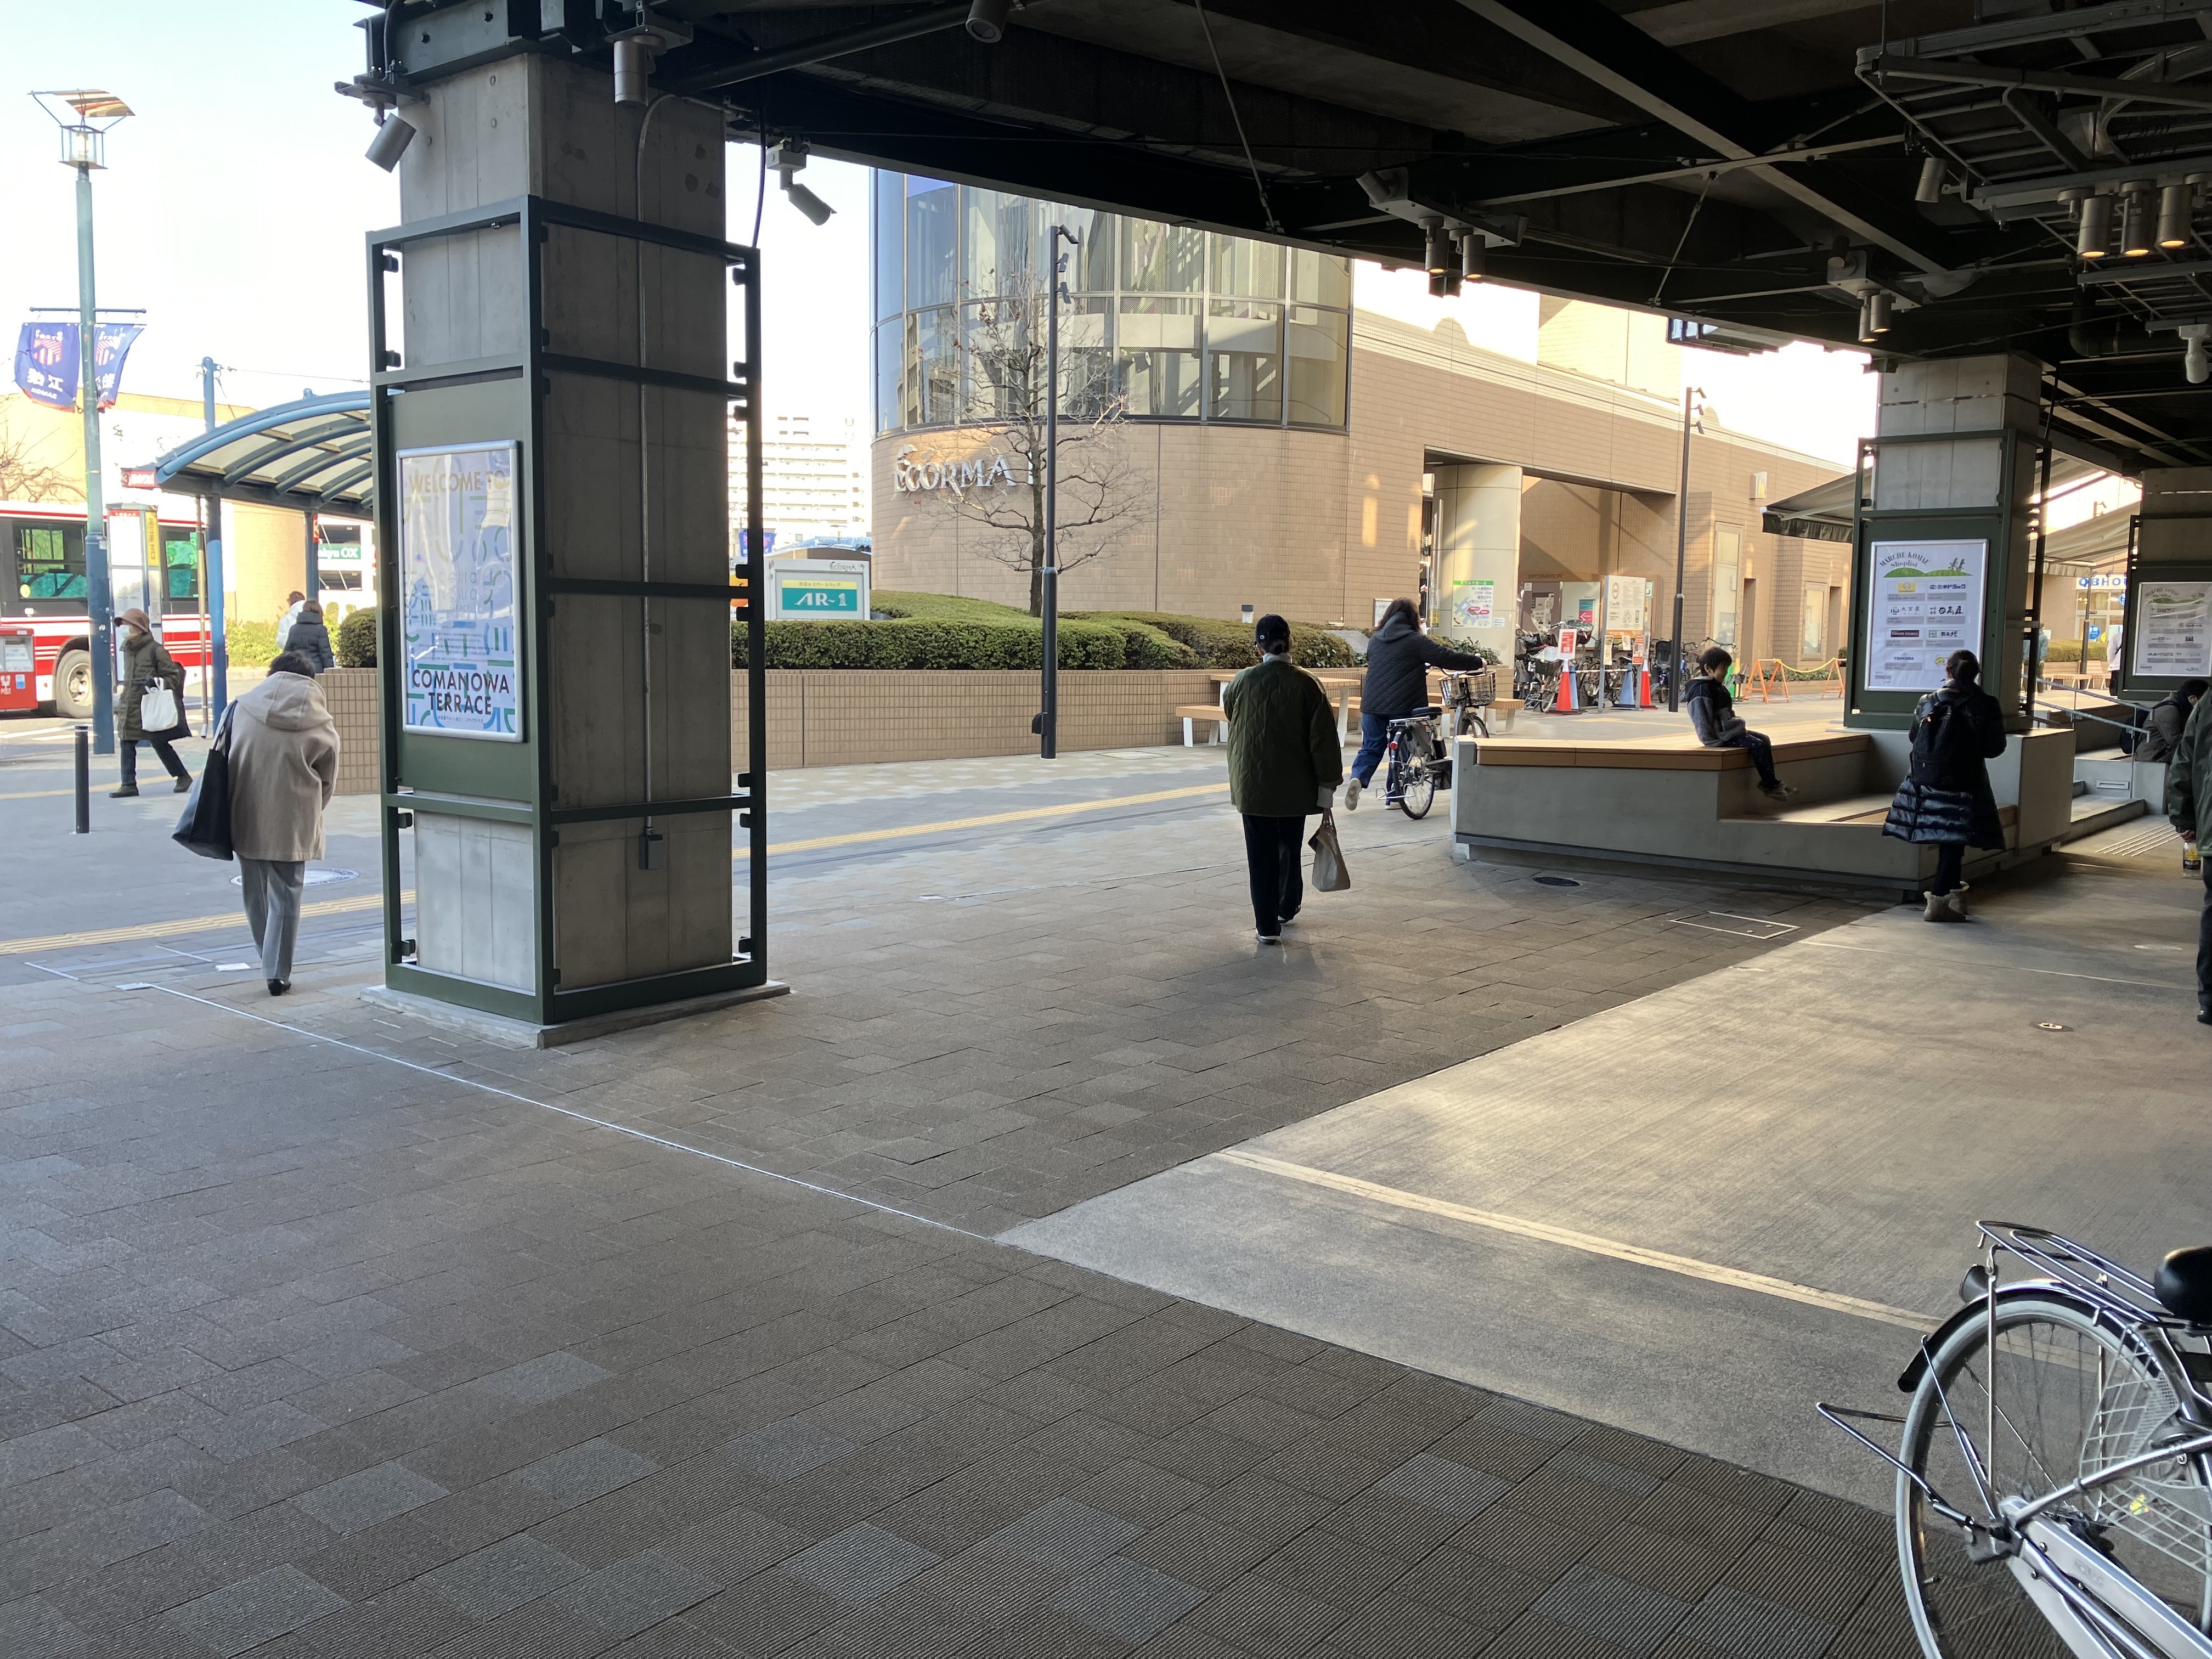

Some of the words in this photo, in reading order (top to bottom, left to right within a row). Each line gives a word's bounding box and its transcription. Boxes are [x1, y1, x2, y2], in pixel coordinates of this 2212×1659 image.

[409, 471, 481, 494] WELCOME
[340, 548, 358, 558] OX
[1880, 552, 1906, 567] MARCHE
[830, 561, 856, 571] ECORMA
[412, 669, 510, 694] COMANOWA
[428, 692, 492, 715] TERRACE
